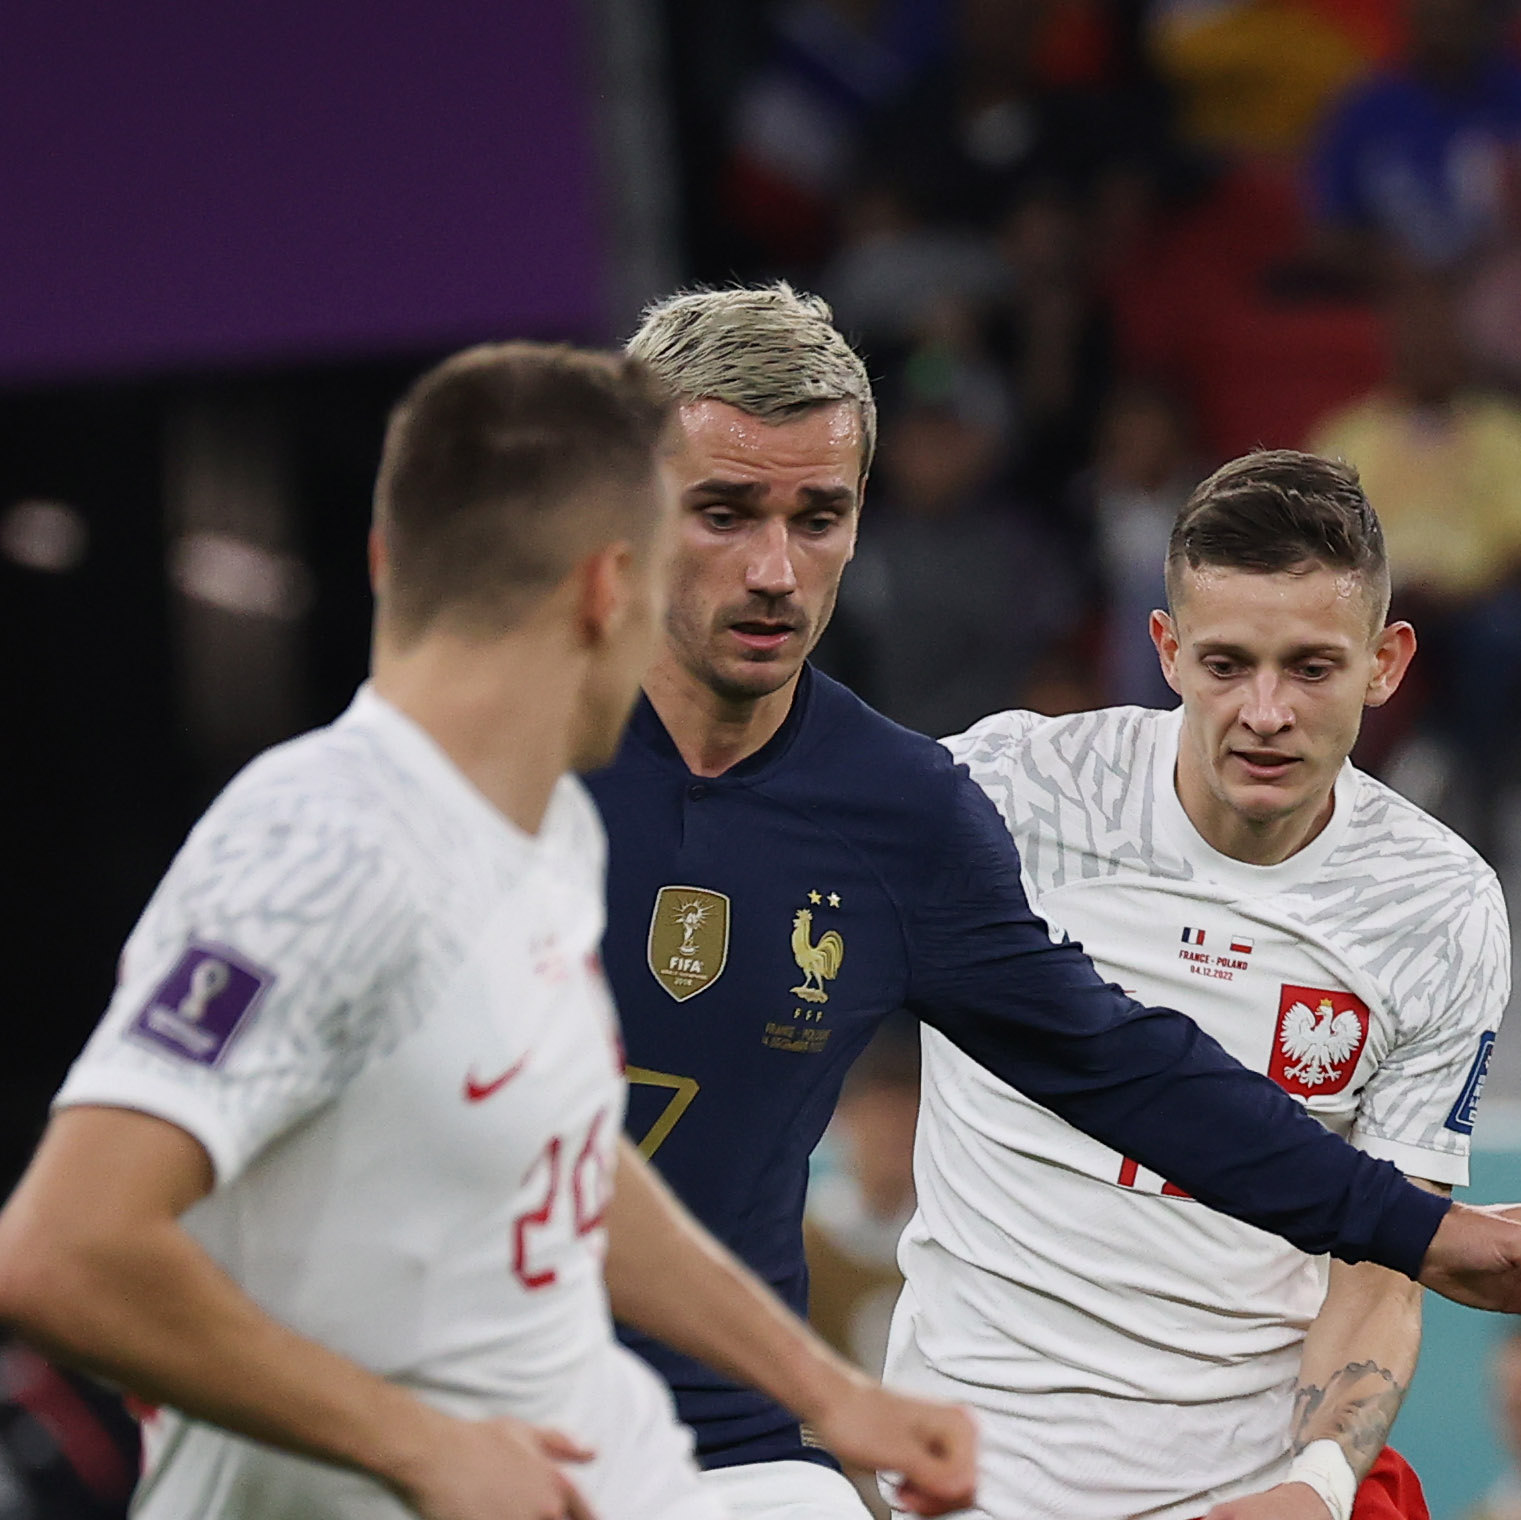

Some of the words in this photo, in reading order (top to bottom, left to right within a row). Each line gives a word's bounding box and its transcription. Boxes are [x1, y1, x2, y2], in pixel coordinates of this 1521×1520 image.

[669, 956, 701, 973] FIFA
[1179, 949, 1210, 964] FRANCE
[1216, 957, 1248, 971] POLAND
